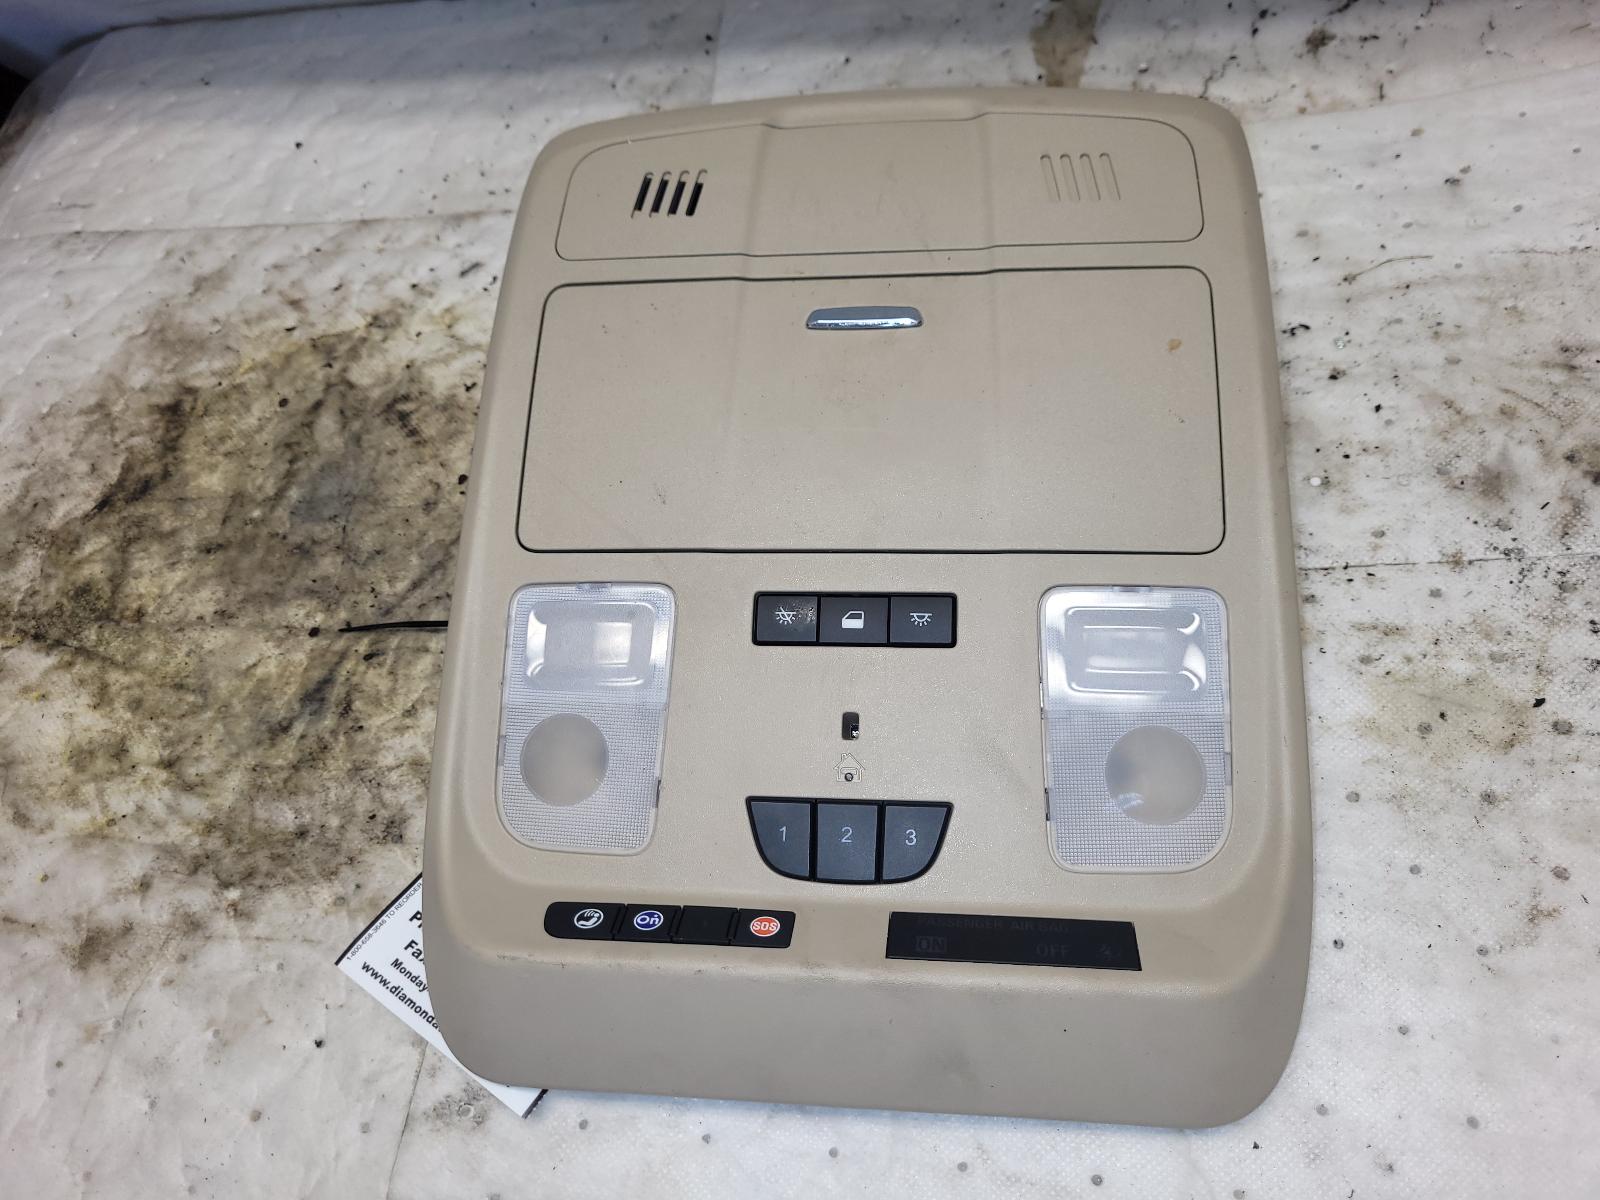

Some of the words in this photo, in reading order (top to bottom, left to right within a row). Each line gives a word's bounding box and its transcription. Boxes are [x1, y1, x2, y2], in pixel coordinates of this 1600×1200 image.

[778, 825, 787, 843] 1
[840, 826, 853, 843] 2
[905, 829, 917, 846] 3
[385, 909, 396, 921] TO
[636, 914, 660, 925] On
[752, 921, 778, 931] SOS
[361, 961, 442, 1033] www.diamonda
